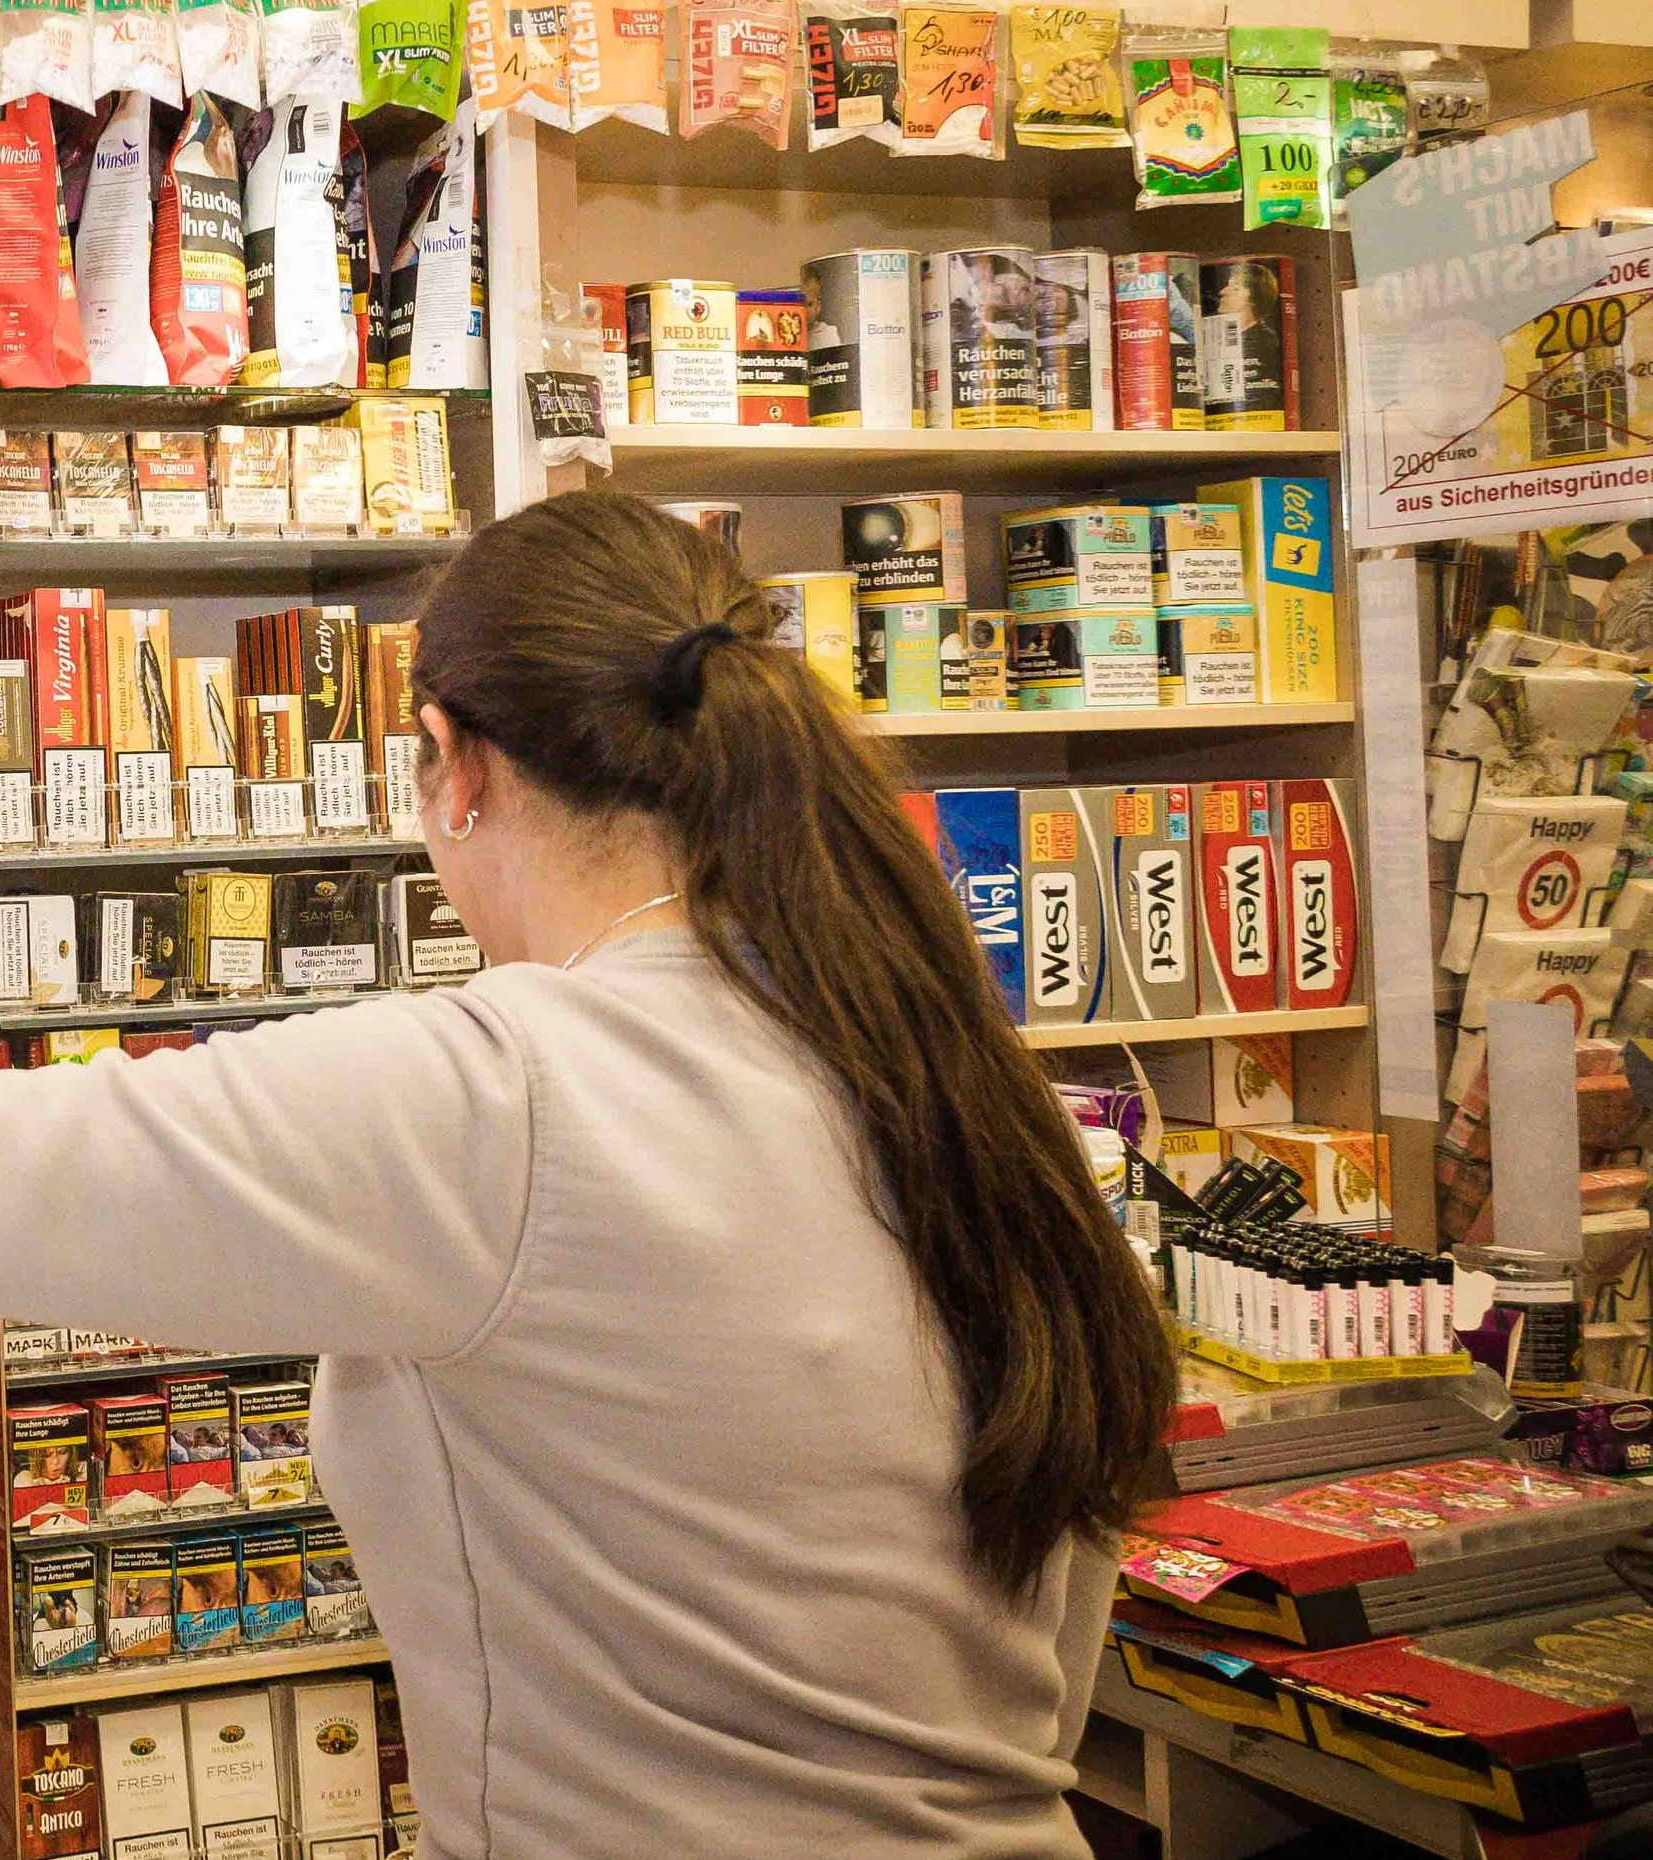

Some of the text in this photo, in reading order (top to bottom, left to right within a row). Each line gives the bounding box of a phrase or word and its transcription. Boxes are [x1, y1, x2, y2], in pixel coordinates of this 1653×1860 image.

[632, 13, 659, 24] SLIM
[619, 23, 660, 36] FILTER
[730, 20, 757, 40] XL
[840, 29, 893, 47] XL SLIM
[742, 39, 778, 55] FILTER
[854, 45, 894, 58] FILTER
[377, 50, 407, 73] XL
[692, 19, 714, 111] GIZEH
[807, 24, 836, 117] GIZEH
[97, 150, 140, 171] Winston
[1262, 143, 1312, 173] 100
[423, 235, 466, 254] Winston
[663, 327, 732, 341] RED BULL
[1533, 296, 1627, 360] 200
[958, 346, 1026, 363] Rauchen
[756, 370, 784, 382] Lunge
[150, 462, 195, 476] TOSCANELLO
[1393, 452, 1435, 479] 200
[1396, 493, 1433, 514] aus
[871, 556, 939, 570] erhöht das
[1093, 560, 1147, 570] Rauchen ist
[1185, 557, 1237, 568] Rauchen ist
[874, 570, 935, 586] erblinden
[1086, 572, 1119, 583] tödlich
[1177, 569, 1208, 579] tödlich
[315, 620, 335, 673] Curly
[53, 614, 78, 702] Virginia
[1200, 662, 1251, 671] Rauchen ist
[1137, 796, 1150, 829] 200
[1295, 814, 1308, 848] 200
[1529, 816, 1595, 843] Happy
[1035, 824, 1048, 858] 250
[1529, 872, 1569, 910] 50
[300, 909, 355, 924] SAMBA
[1145, 859, 1177, 972] West
[1234, 855, 1264, 966] West
[1300, 872, 1328, 981] West
[414, 942, 477, 956] Rauchen kann
[1041, 884, 1069, 997] West
[301, 946, 356, 959] Rauchen ist
[419, 955, 449, 967] tödlich
[295, 956, 362, 968] tödlich hören
[1537, 950, 1599, 975] Happy
[1132, 1161, 1145, 1195] CLICK
[170, 1382, 208, 1393] Das Rauchen
[15, 1417, 69, 1430] Rauchen schädigt
[16, 1427, 49, 1438] Ihre Lunge
[290, 1460, 306, 1470] NEU
[67, 1487, 85, 1497] NEU
[33, 1560, 91, 1575] Rauchen verstopft
[109, 1615, 172, 1656] Chesterfield
[177, 1607, 239, 1650] Chesterfield
[33, 1627, 96, 1667] Chesterfield
[207, 1760, 264, 1777] FRESH
[34, 1767, 84, 1790] TOSCANO
[117, 1773, 176, 1792] FRESH
[40, 1810, 83, 1834] ANTICO
[214, 1825, 267, 1840] Rauchen ist
[124, 1838, 179, 1854] Rauchen ist
